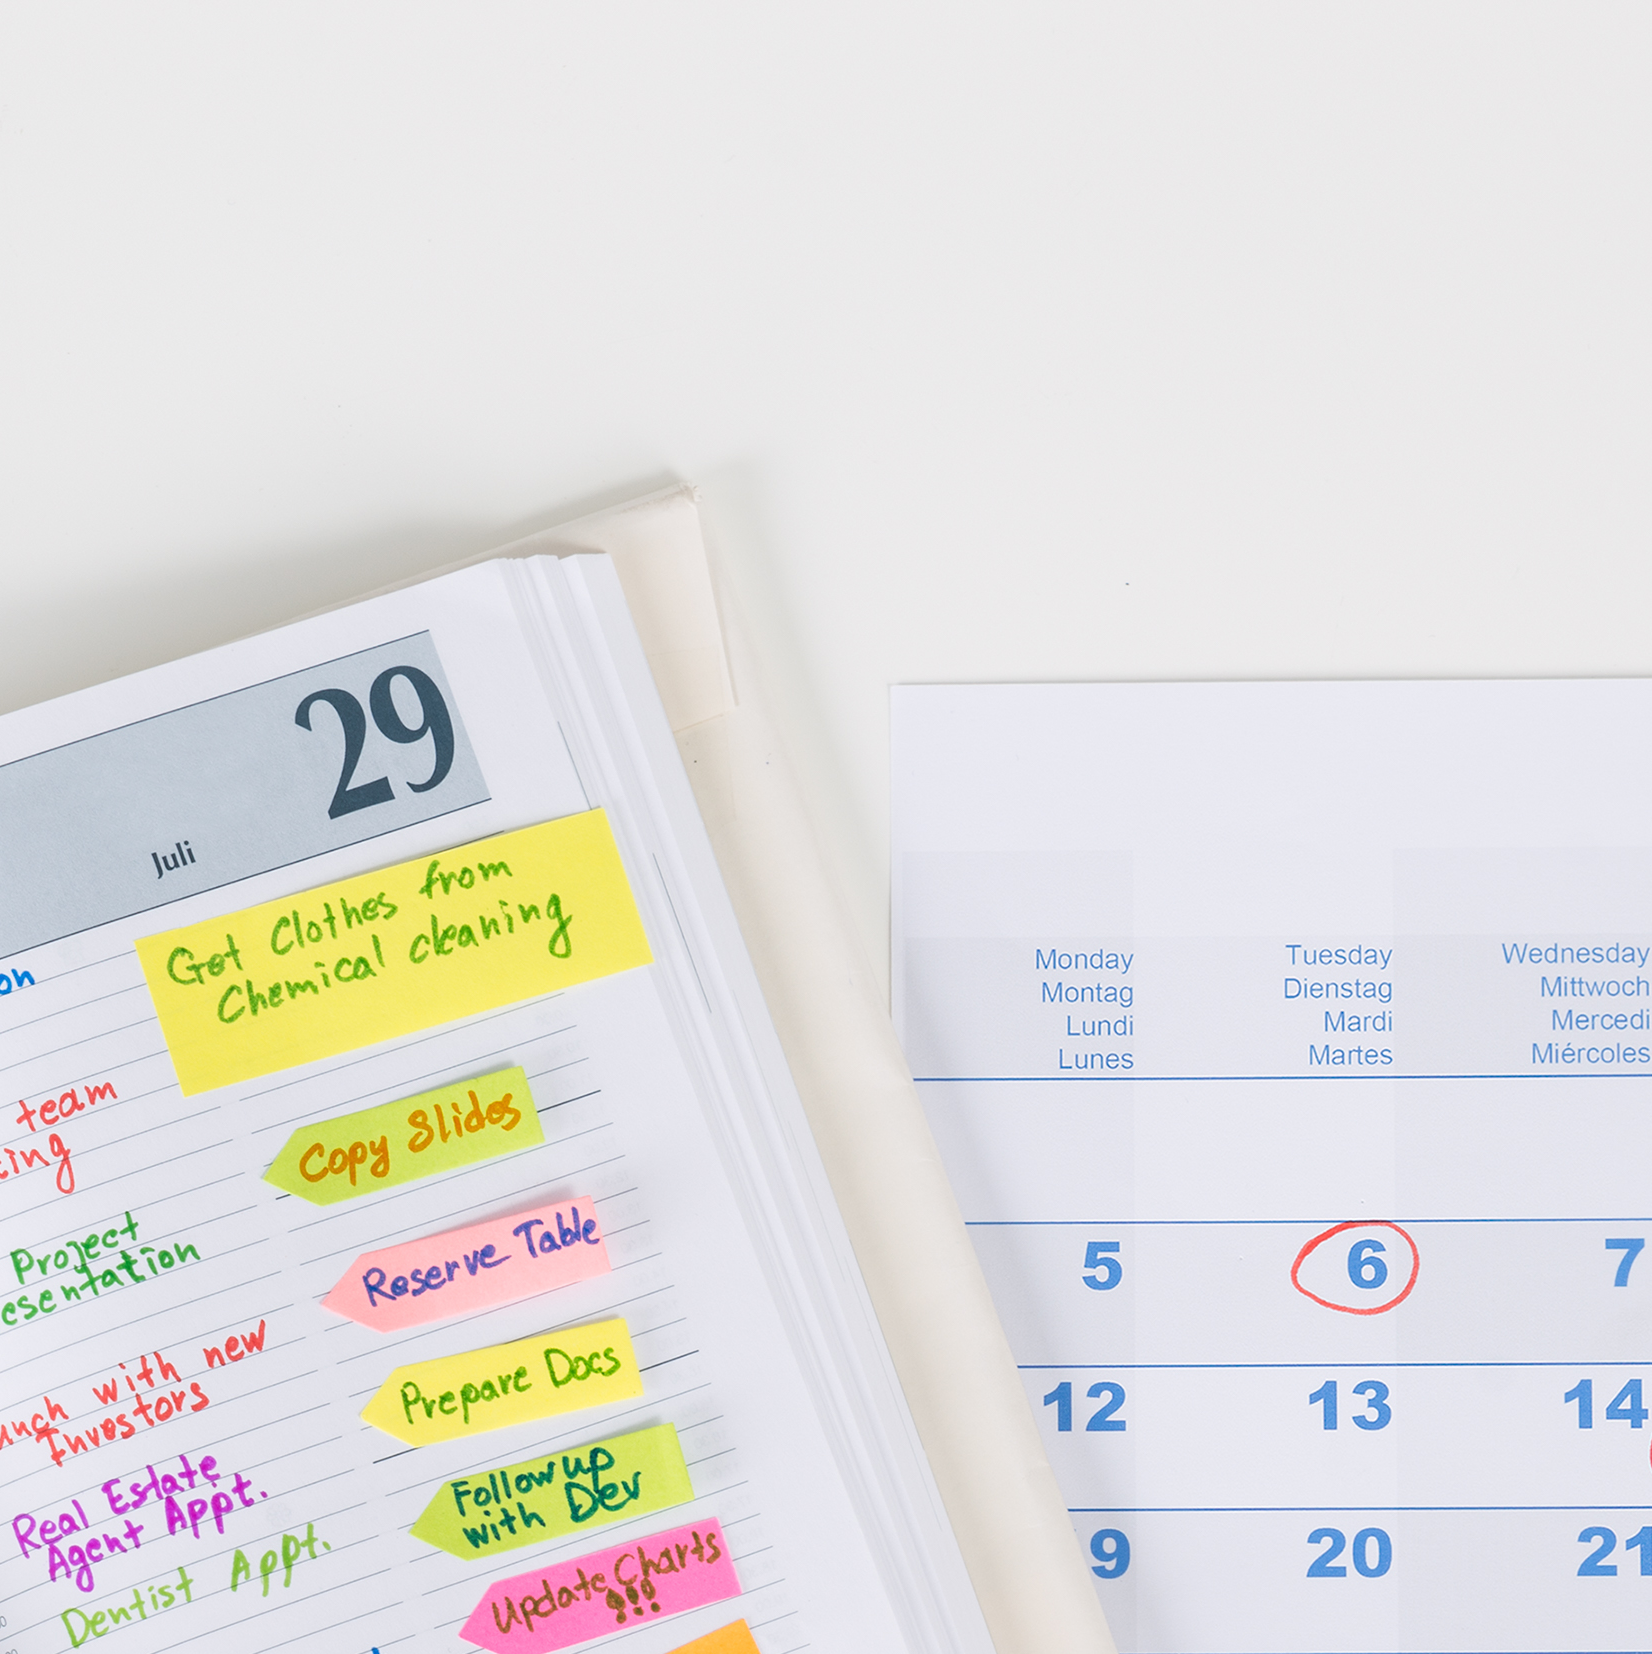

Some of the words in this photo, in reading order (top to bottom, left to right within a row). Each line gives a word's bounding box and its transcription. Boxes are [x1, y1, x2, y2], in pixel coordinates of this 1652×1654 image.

[295, 665, 455, 820] 29
[151, 840, 196, 879] Juli
[270, 892, 398, 955] Clothes
[419, 860, 513, 899] from
[217, 934, 385, 1024] Chemical
[409, 893, 573, 964] cleaning
[1036, 949, 1133, 974] Monday
[1286, 945, 1392, 969] Tuesday
[1502, 943, 1650, 968] Wednesday
[1043, 982, 1133, 1008] Montag
[1285, 978, 1392, 1003] Dienstag
[1542, 976, 1649, 996] Mittwoch
[1068, 1016, 1133, 1036] Lundi
[1325, 1011, 1392, 1032] Mardi
[1553, 1009, 1649, 1030] Mercedi
[1060, 1049, 1133, 1069] Lunes
[1310, 1045, 1393, 1065] Martes
[1533, 1043, 1650, 1063] Miércoles
[16, 1082, 118, 1132] team
[299, 1135, 390, 1186] Copy
[407, 1090, 521, 1153] Slides
[10, 1211, 139, 1285] Project
[362, 1244, 511, 1307] Reserve
[512, 1206, 600, 1258] Table
[1082, 1242, 1122, 1290] 5
[1348, 1239, 1387, 1289] 6
[1605, 1238, 1645, 1287] 7
[92, 1351, 181, 1405] with
[203, 1319, 265, 1369] new
[400, 1366, 532, 1424] Prepare
[544, 1347, 621, 1389] Docs
[35, 1382, 210, 1468] Investors
[1044, 1382, 1126, 1431] 12
[1309, 1380, 1391, 1430] 13
[1564, 1379, 1648, 1429] 14
[12, 1499, 89, 1559] Real
[101, 1454, 220, 1515] Estate
[462, 1501, 546, 1549] with
[564, 1471, 642, 1523] Dev
[48, 1519, 144, 1593] Agent
[165, 1472, 268, 1539] Appt.
[1085, 1529, 1130, 1579] 9
[1307, 1528, 1392, 1578] 20
[60, 1566, 193, 1648] Dentist
[230, 1522, 331, 1597] Appt.
[492, 1567, 608, 1634] Update
[614, 1531, 721, 1586] Charts
